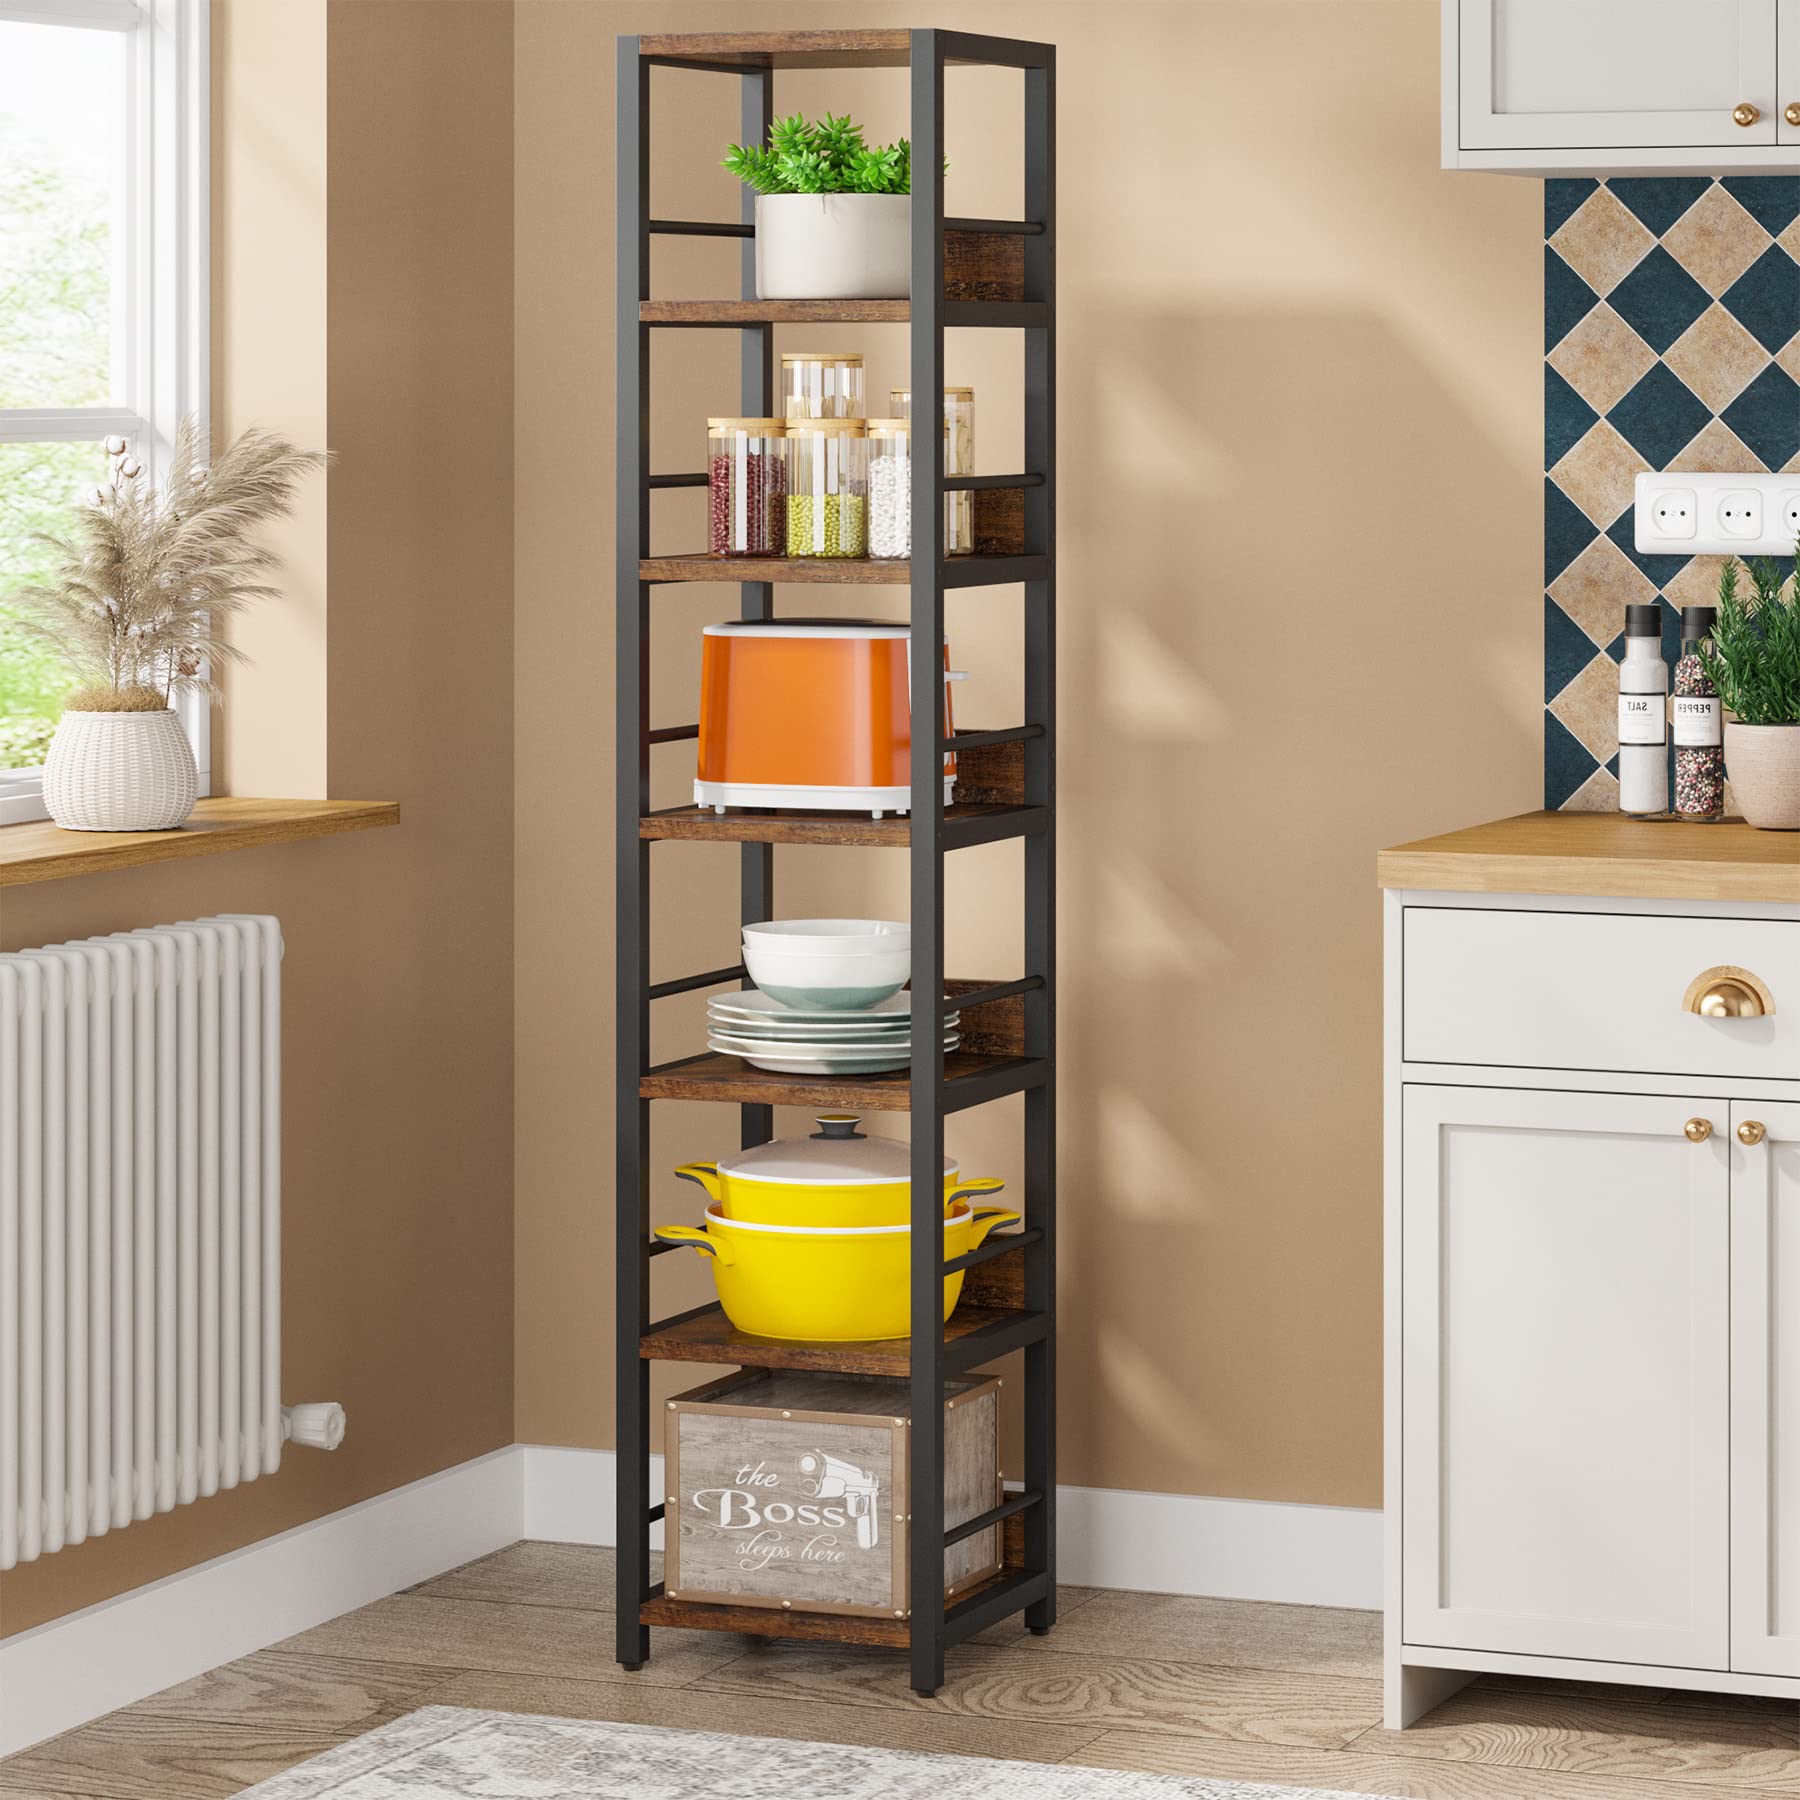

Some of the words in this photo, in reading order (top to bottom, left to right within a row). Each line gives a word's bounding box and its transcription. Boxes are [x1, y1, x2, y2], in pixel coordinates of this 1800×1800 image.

[735, 1461, 780, 1487] the
[735, 1530, 791, 1571] sleeps
[800, 1534, 847, 1563] here
